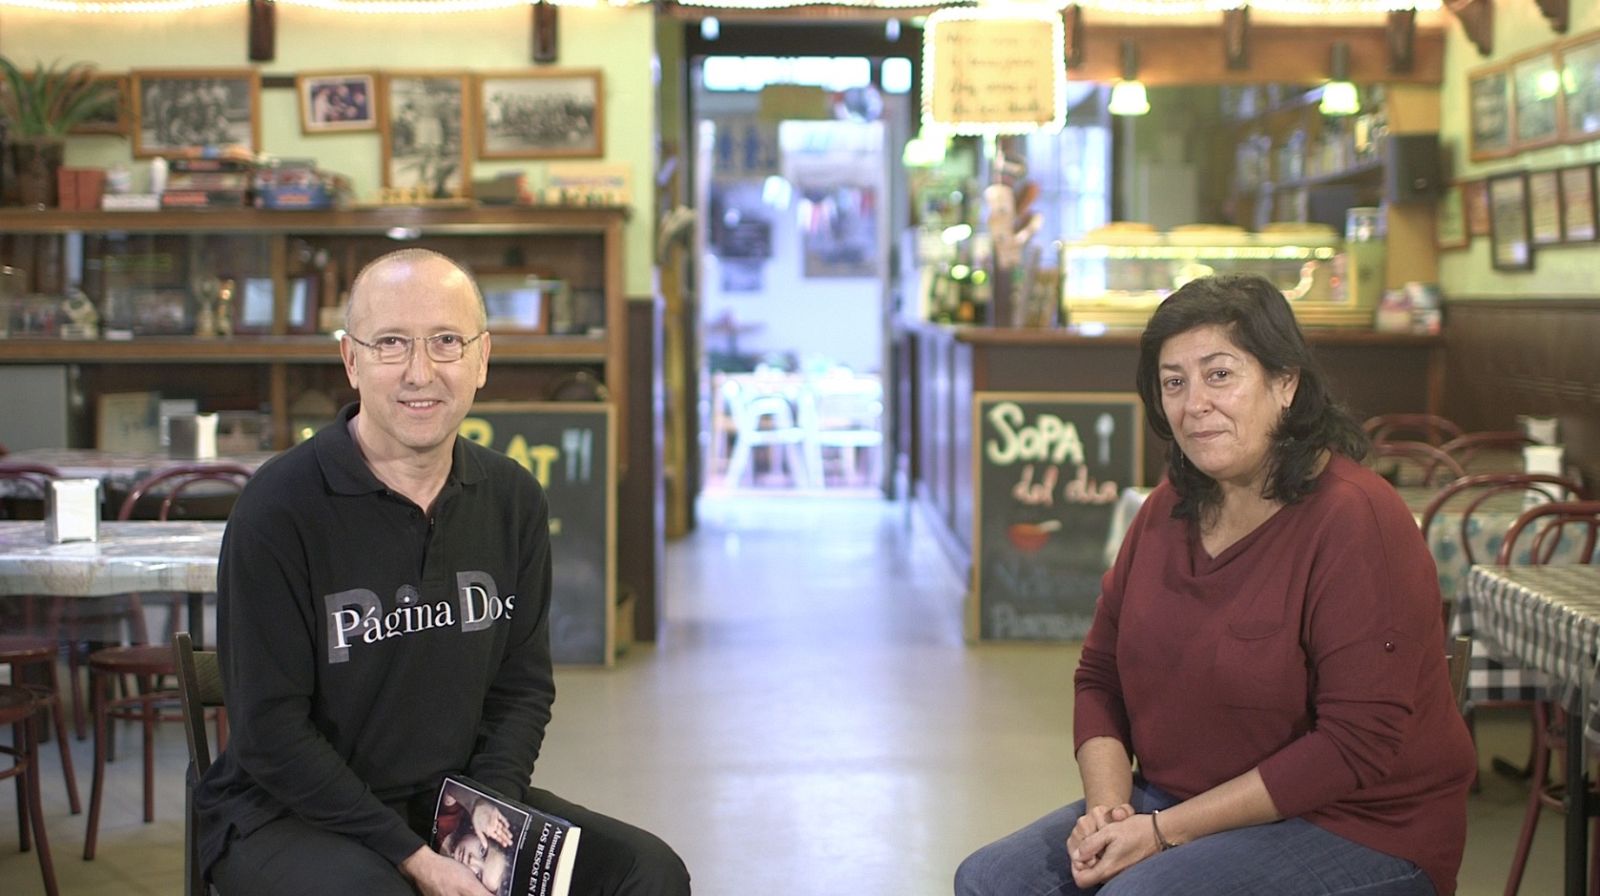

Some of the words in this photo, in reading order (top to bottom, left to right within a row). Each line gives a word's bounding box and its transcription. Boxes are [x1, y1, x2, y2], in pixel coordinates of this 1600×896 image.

[332, 595, 455, 649] Página
[461, 586, 515, 625] Dos
[539, 822, 553, 843] LOS
[544, 826, 563, 870] Almudena
[531, 843, 545, 876] BESOS
[529, 876, 538, 892] EN
